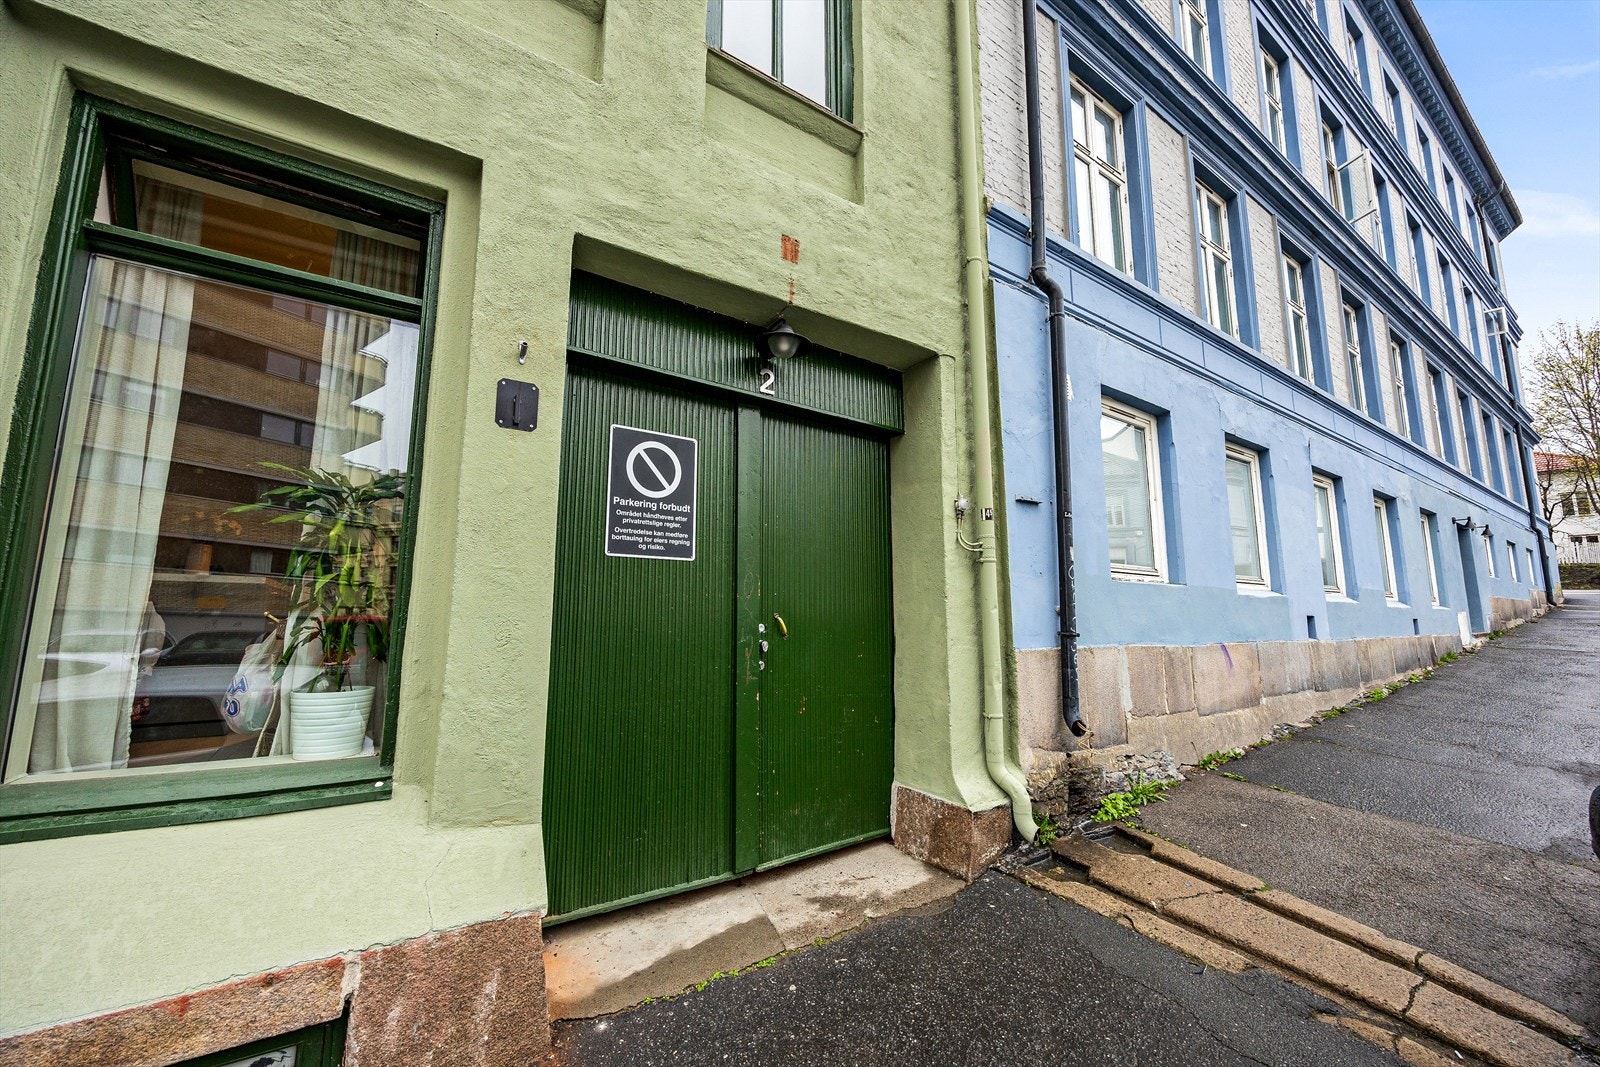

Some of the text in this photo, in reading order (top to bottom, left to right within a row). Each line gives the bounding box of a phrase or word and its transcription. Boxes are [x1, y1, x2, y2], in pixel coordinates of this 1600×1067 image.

[760, 368, 775, 395] 2
[613, 496, 691, 513] Parkering forbudt
[616, 509, 642, 518] Området
[643, 512, 674, 520] håndheves
[622, 518, 663, 527] privatrettslige
[614, 526, 652, 536] Overtredelse
[612, 534, 642, 543] borttauing
